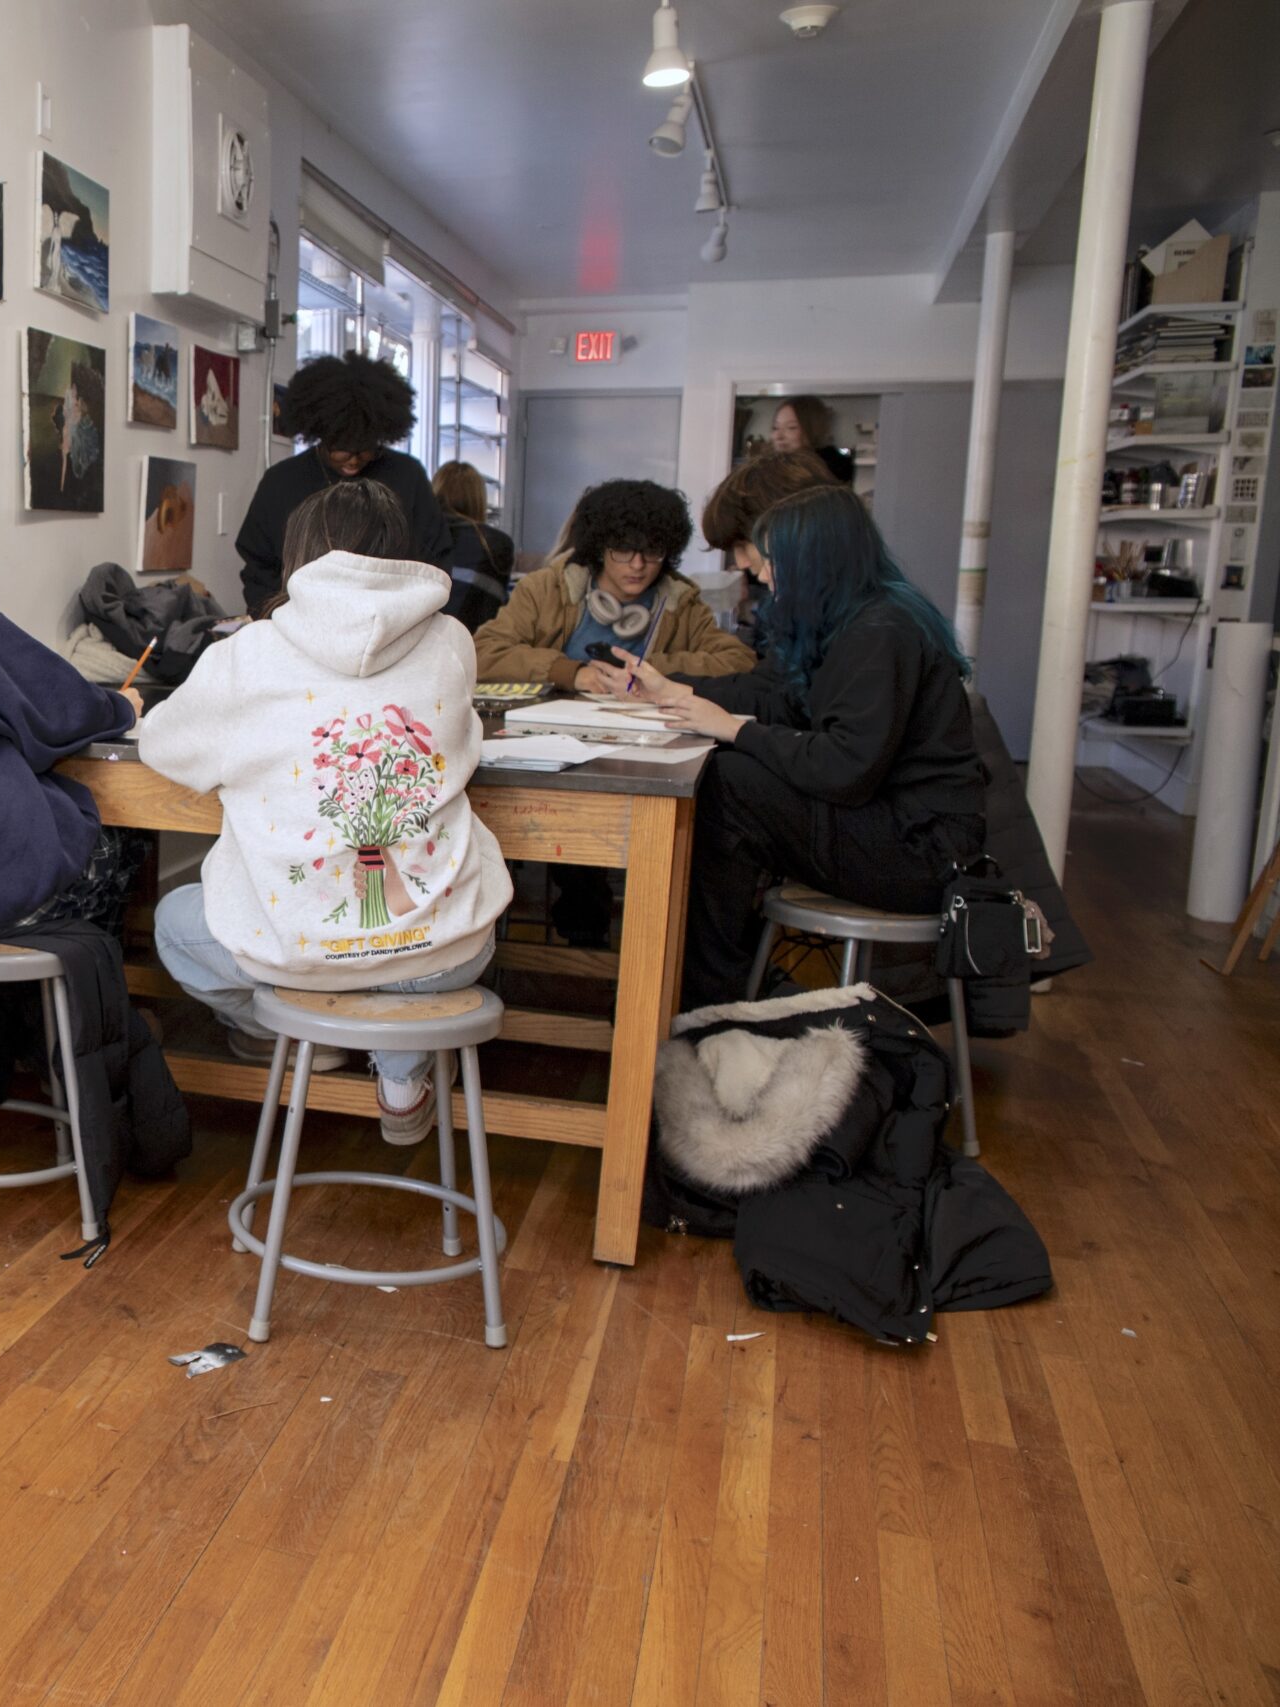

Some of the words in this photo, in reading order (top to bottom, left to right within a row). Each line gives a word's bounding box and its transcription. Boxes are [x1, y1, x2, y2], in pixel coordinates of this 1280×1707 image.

[577, 332, 615, 360] EXIT
[325, 951, 360, 960] COURTESY
[371, 948, 393, 956] DANDY
[393, 941, 433, 954] WORLDWIDE
